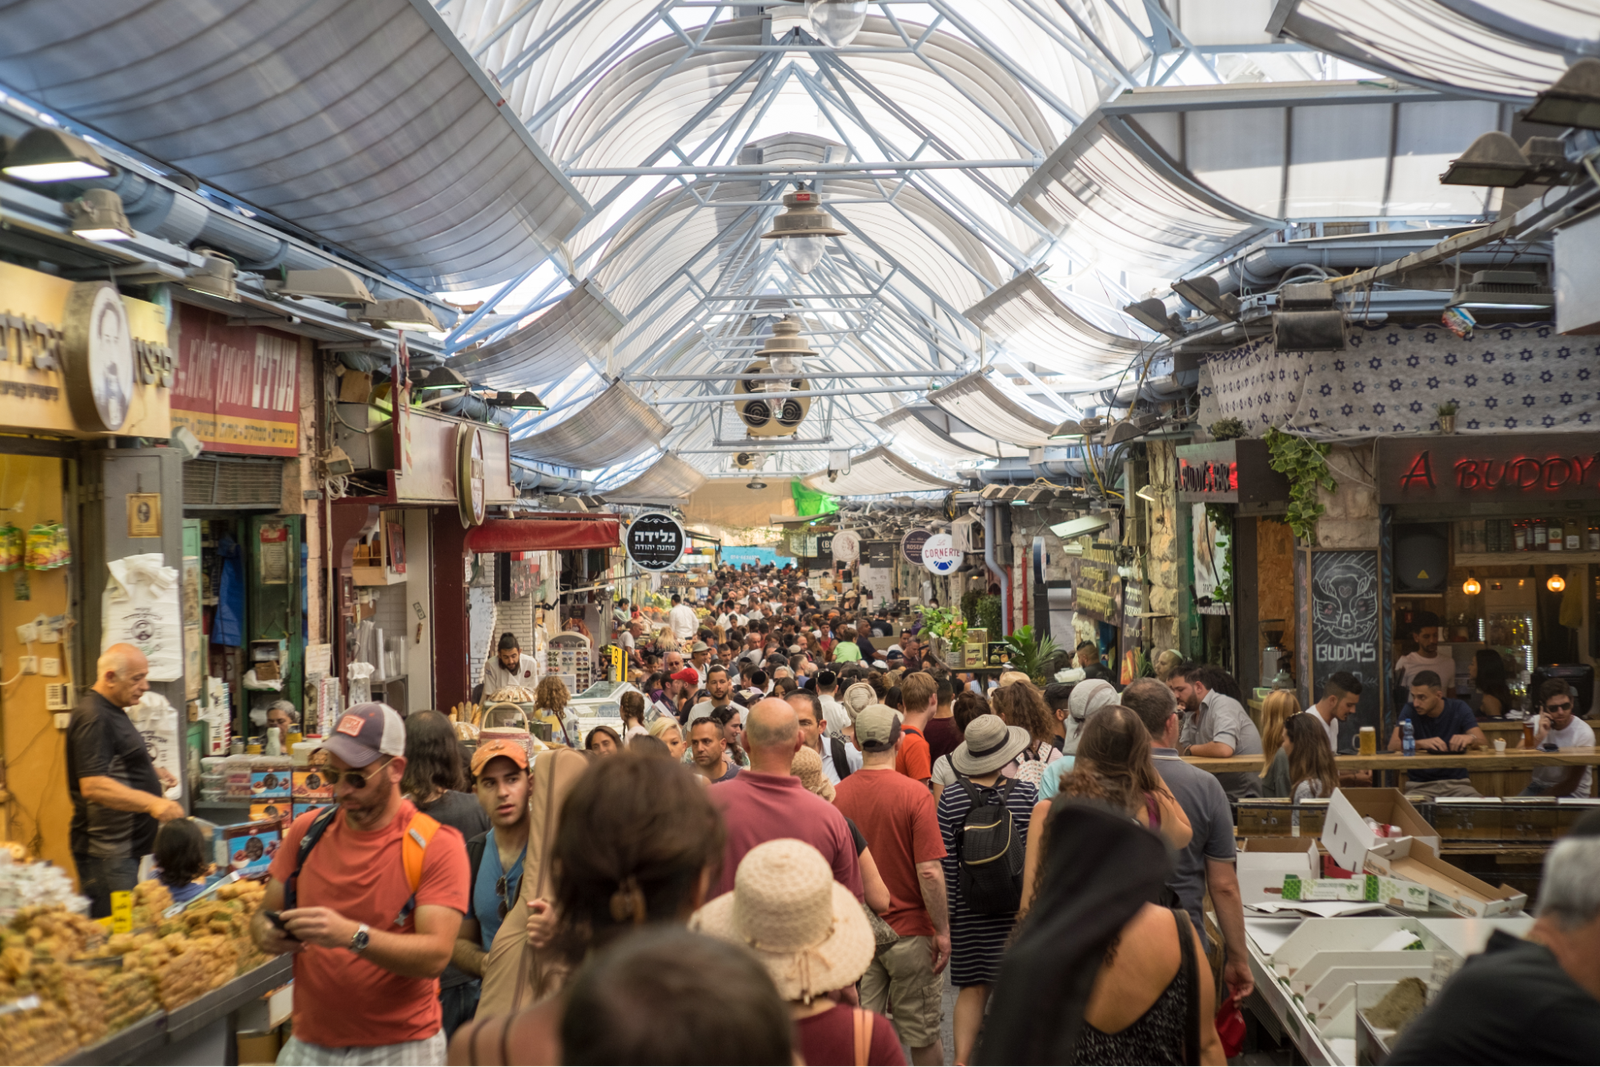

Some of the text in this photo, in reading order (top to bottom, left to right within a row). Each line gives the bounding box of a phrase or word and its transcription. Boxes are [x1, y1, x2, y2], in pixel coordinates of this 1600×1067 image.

[1399, 450, 1436, 491] A
[634, 529, 676, 543] גלידה
[1315, 641, 1377, 663] BUDDYS
